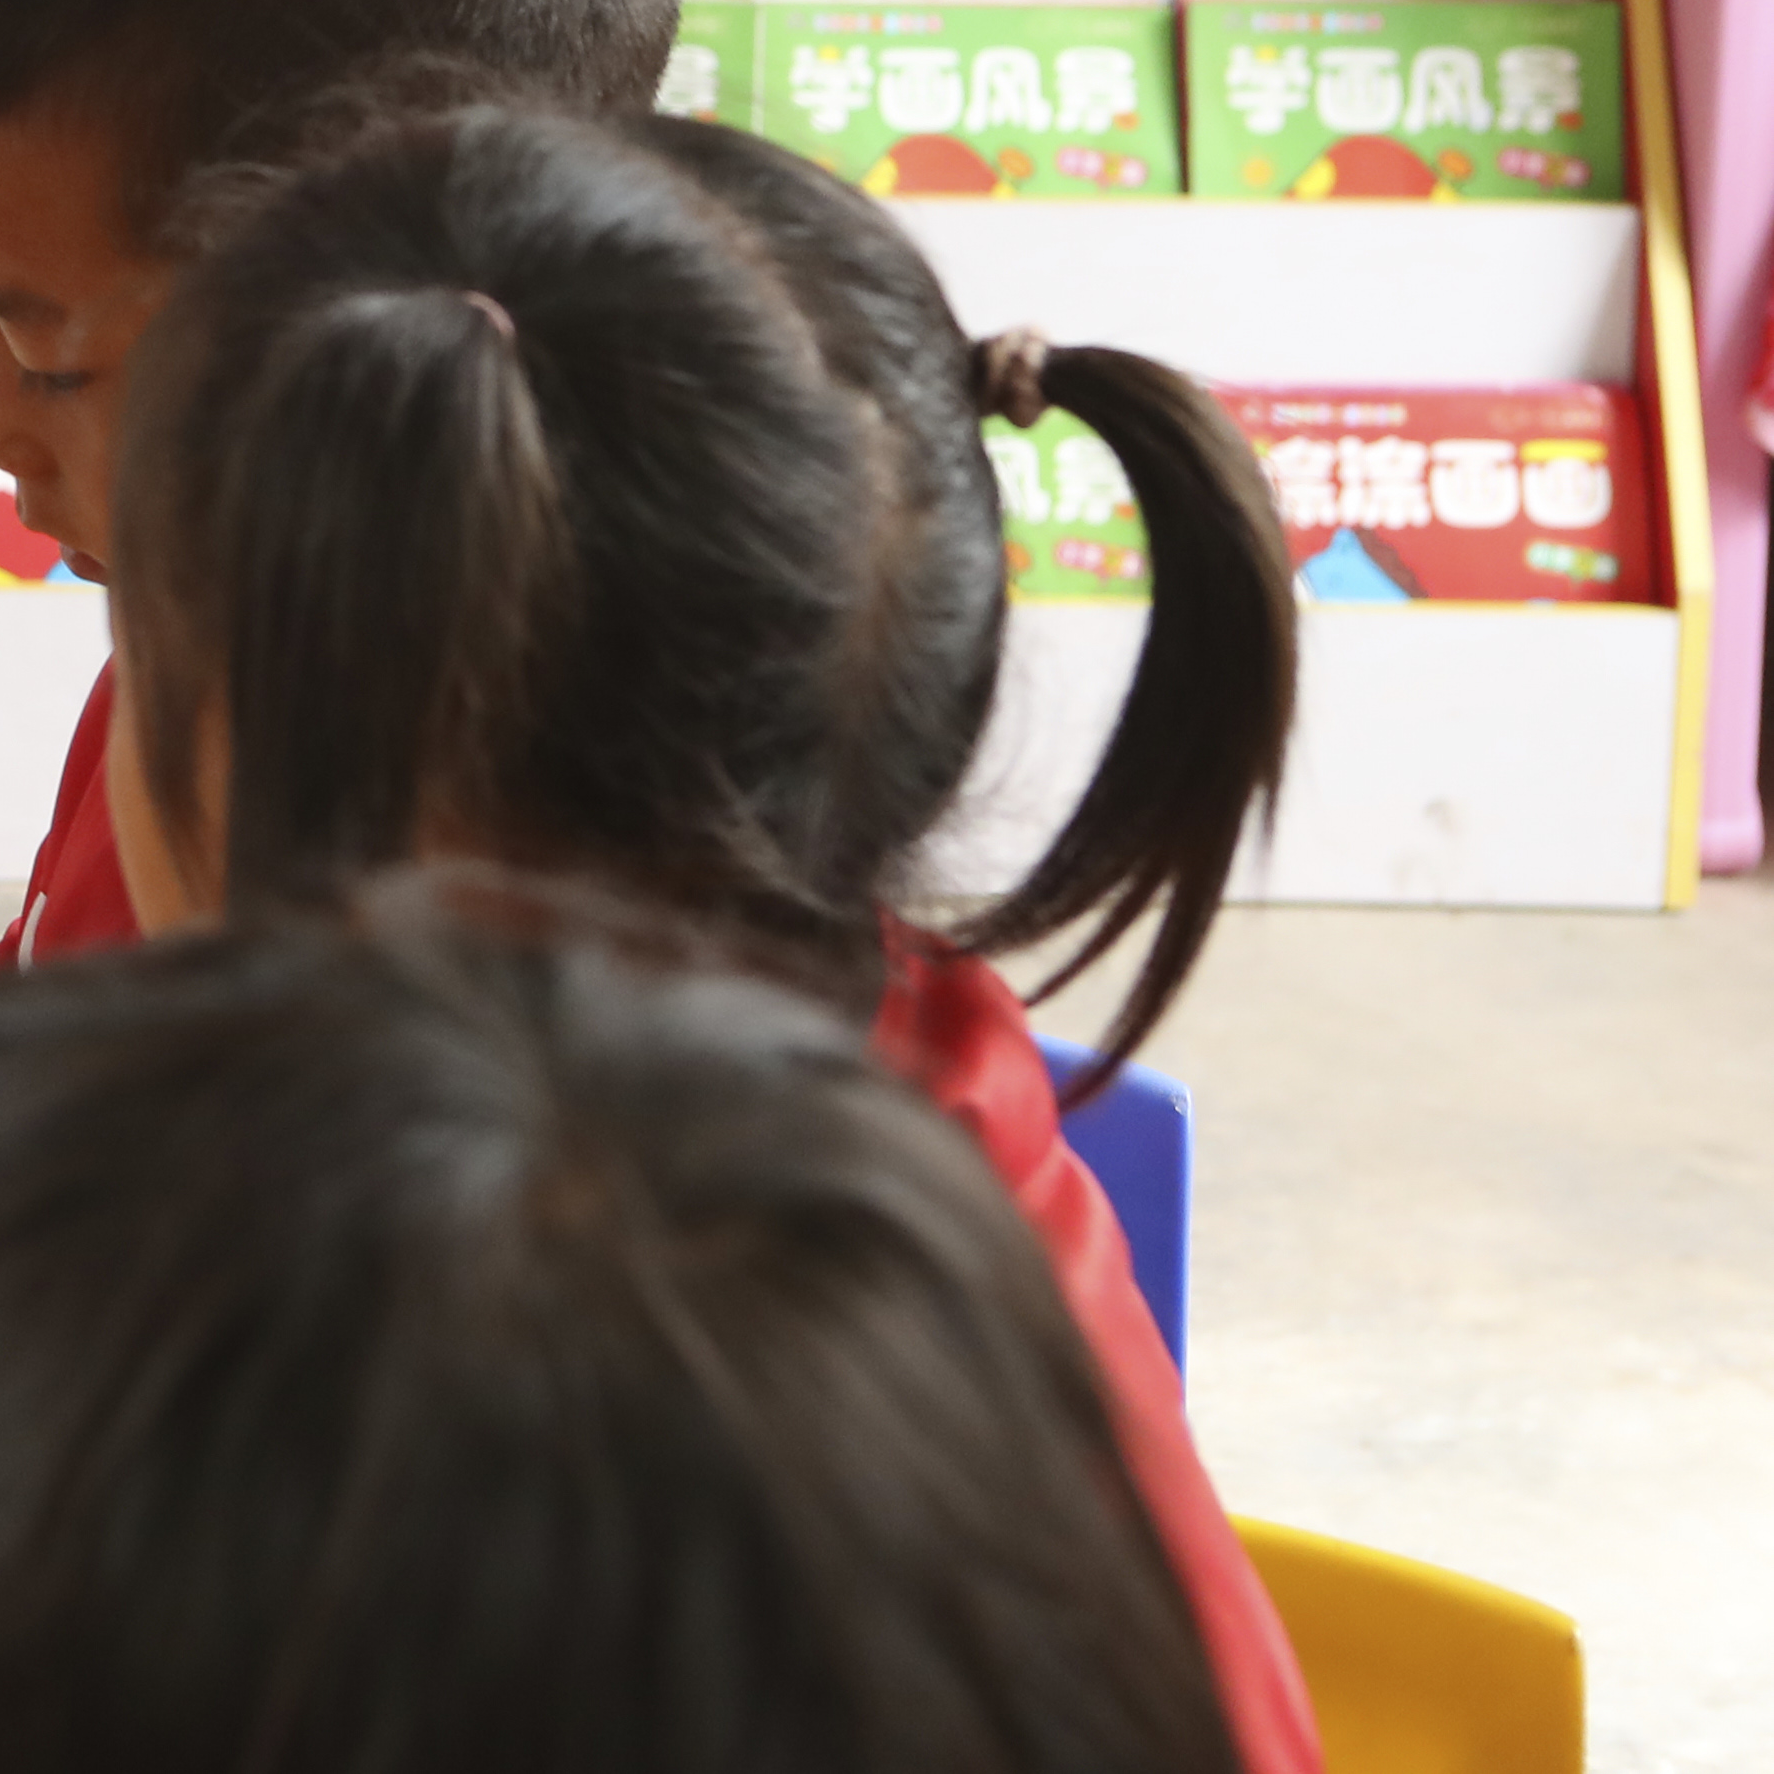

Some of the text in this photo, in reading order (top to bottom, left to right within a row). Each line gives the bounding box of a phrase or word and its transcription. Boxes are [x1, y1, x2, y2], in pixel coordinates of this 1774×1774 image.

[788, 45, 1140, 134] 学画风景
[1225, 44, 1582, 135] 学画风景
